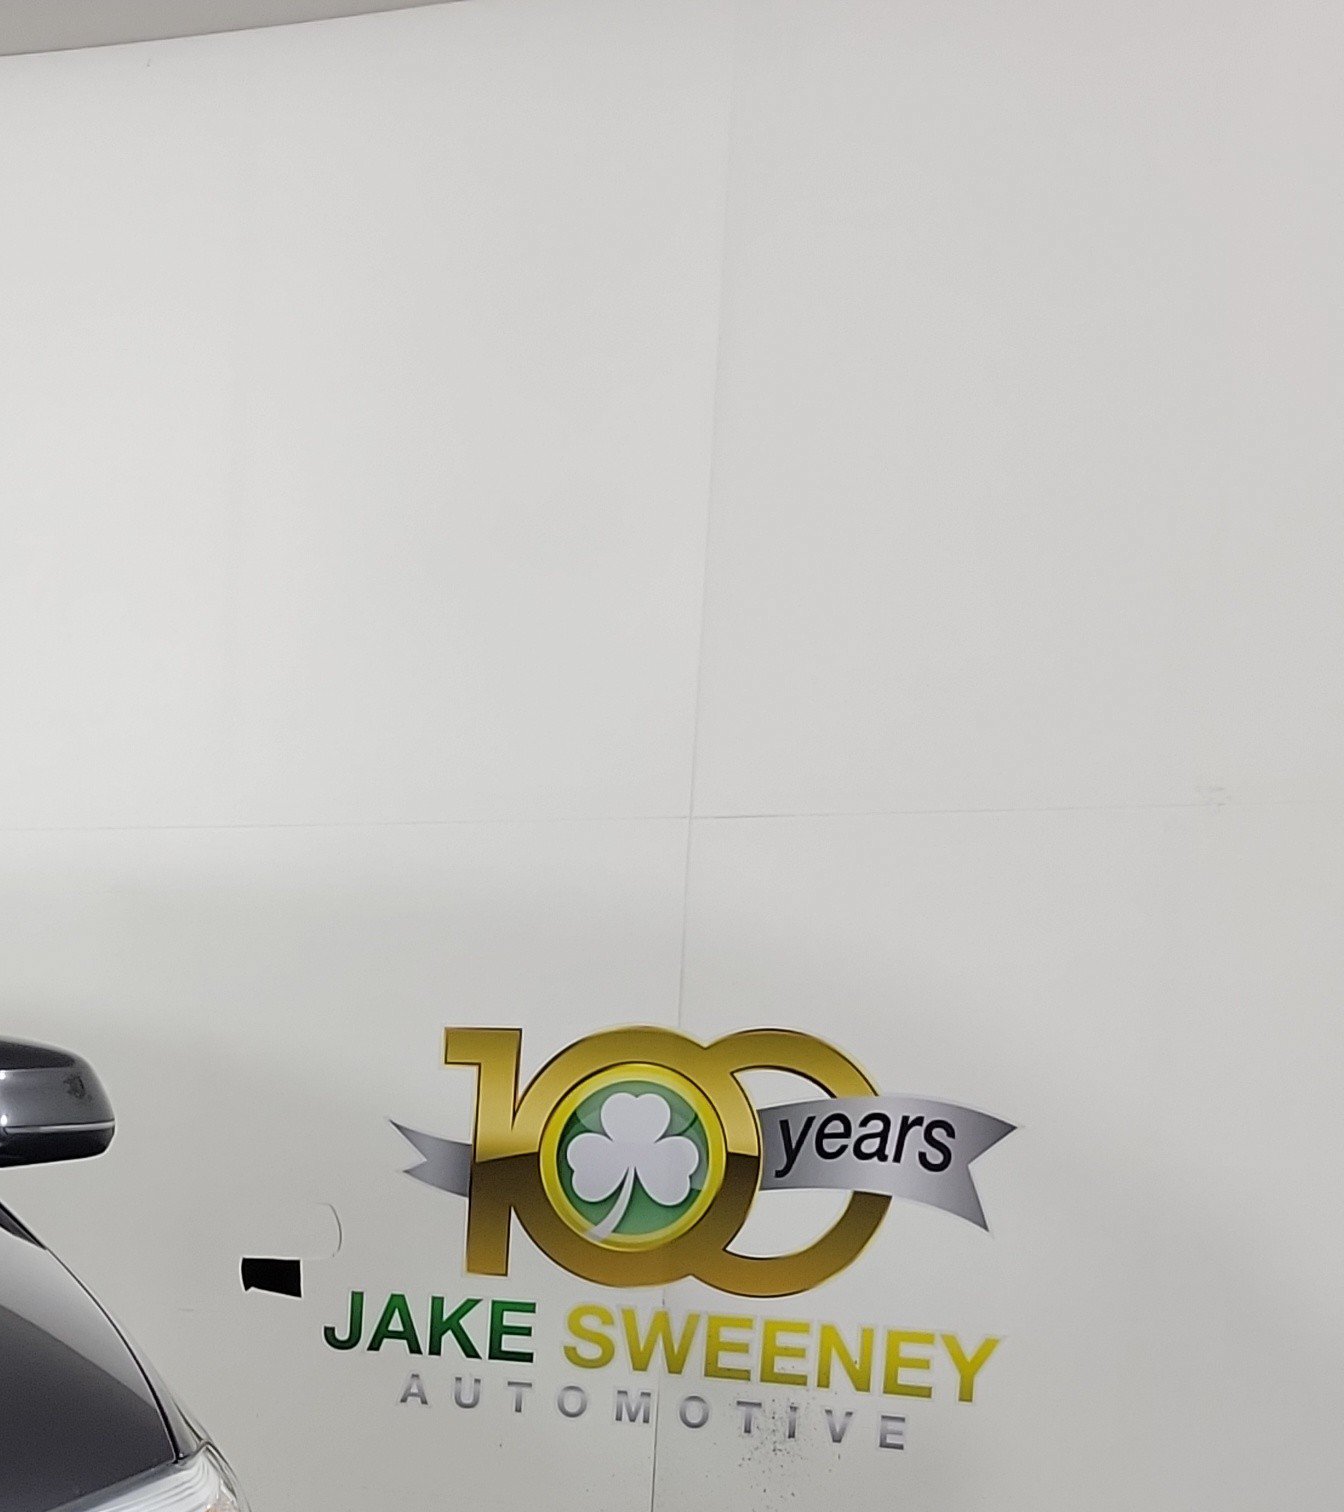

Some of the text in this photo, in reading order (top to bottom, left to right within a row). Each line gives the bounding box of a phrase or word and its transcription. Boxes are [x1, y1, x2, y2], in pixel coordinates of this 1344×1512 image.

[443, 1025, 957, 1299] 100 years
[322, 1290, 1001, 1404] JAKE SWEENEY
[399, 1373, 907, 1452] AUTOMOTIVE
